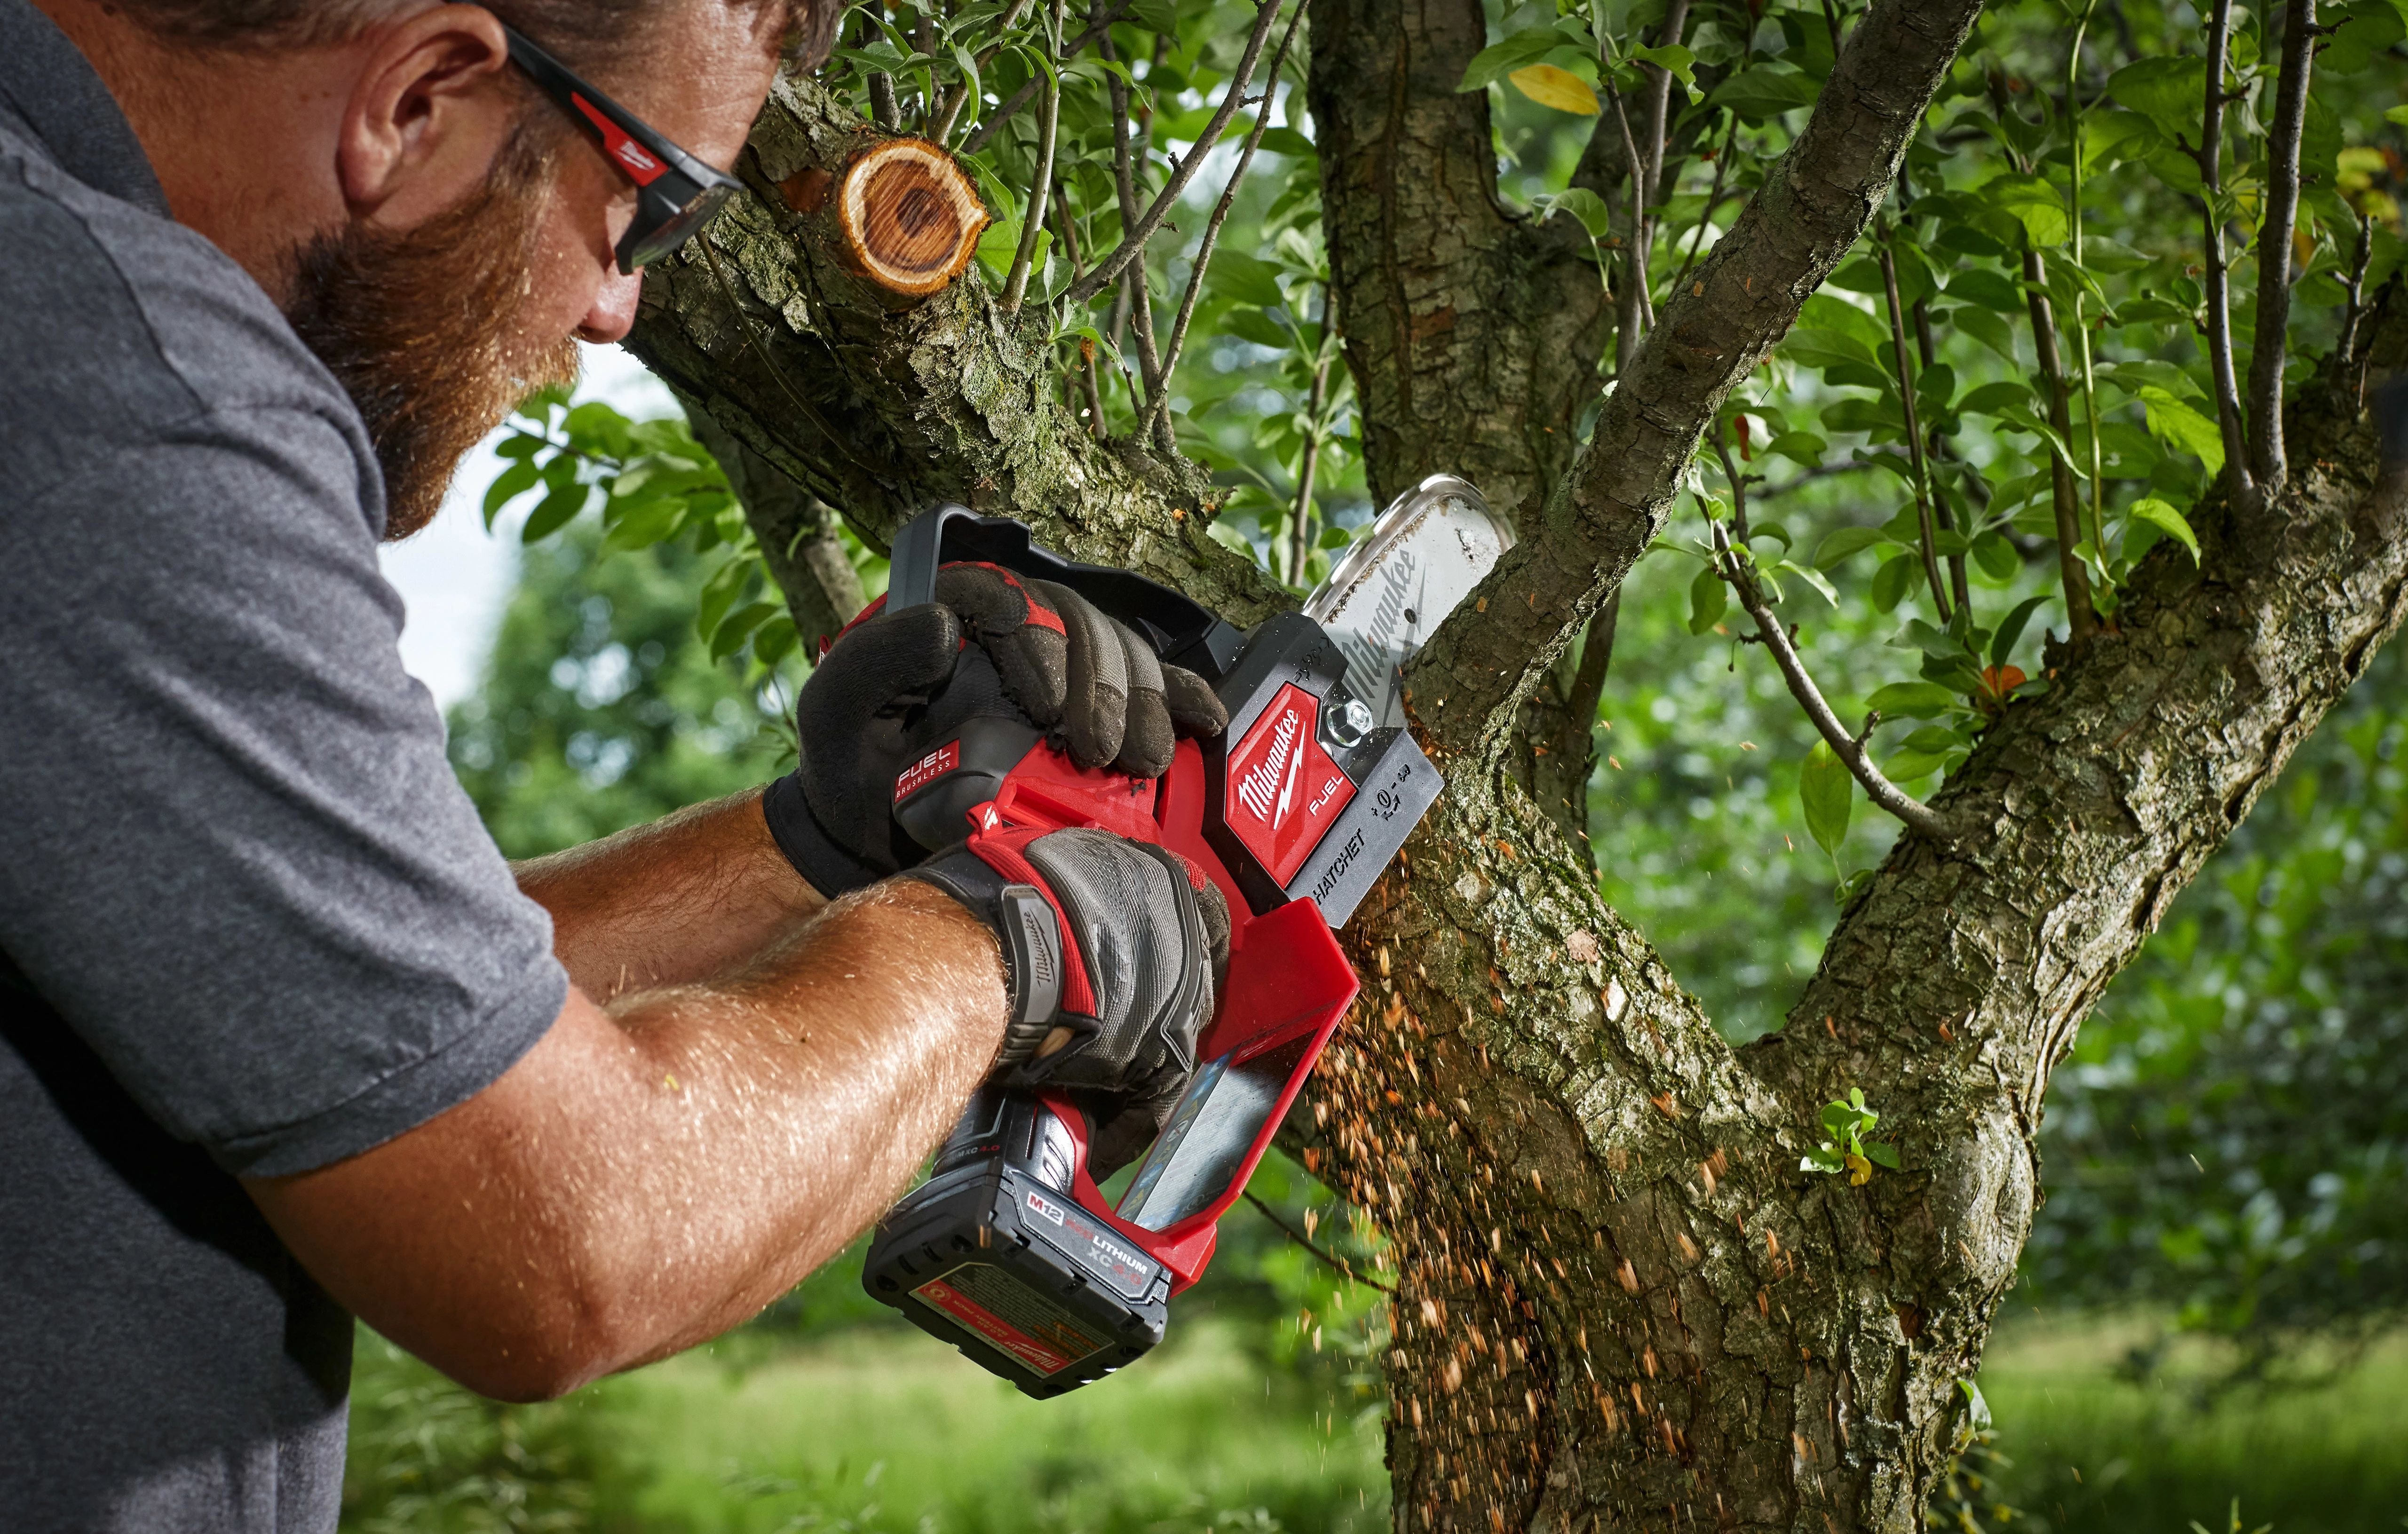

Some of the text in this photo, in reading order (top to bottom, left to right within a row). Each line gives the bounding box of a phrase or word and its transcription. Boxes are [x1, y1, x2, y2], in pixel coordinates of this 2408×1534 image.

[1341, 549, 1415, 712] Milwaukee
[896, 760, 950, 798] BRUSHLESS
[898, 749, 951, 786] FUEL
[1238, 709, 1299, 822] Milwaukee
[1308, 776, 1344, 817] FUEL
[1313, 827, 1364, 906] HATCHET
[1023, 910, 1051, 988] Milwaukee
[1029, 1194, 1063, 1222] M12
[1087, 1246, 1113, 1268] XC
[1005, 1341, 1060, 1369] Milwaukee
